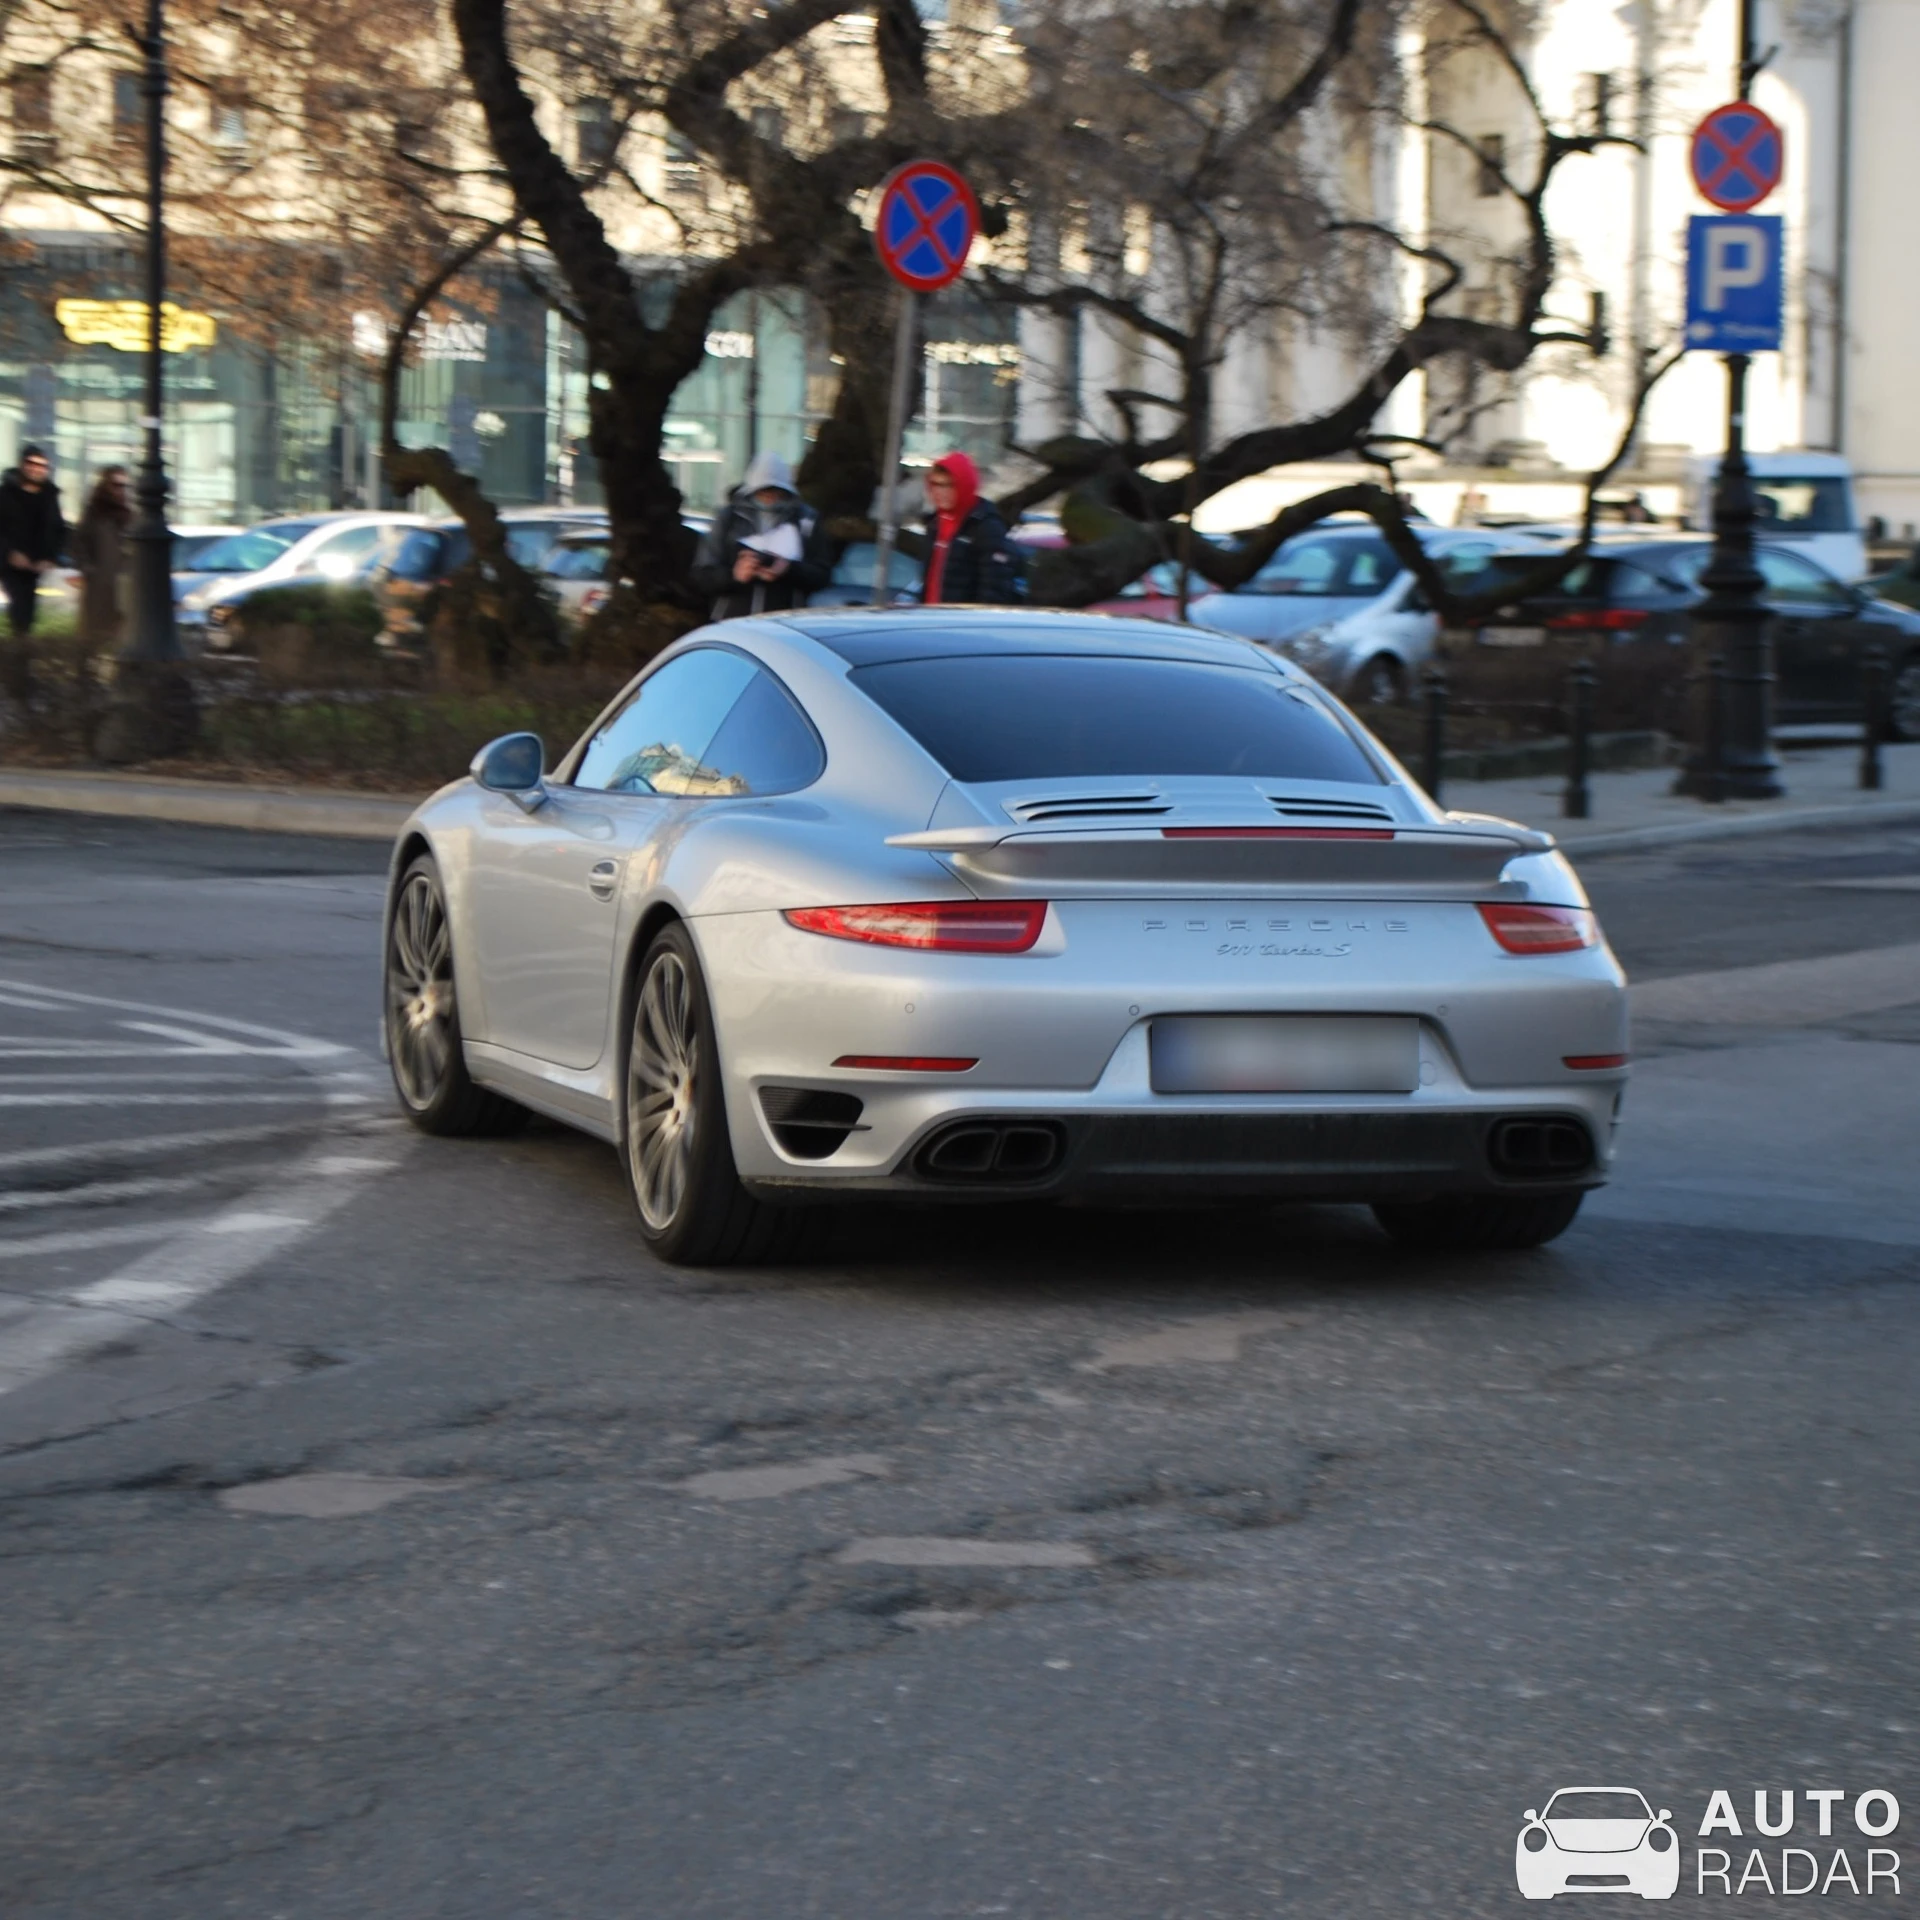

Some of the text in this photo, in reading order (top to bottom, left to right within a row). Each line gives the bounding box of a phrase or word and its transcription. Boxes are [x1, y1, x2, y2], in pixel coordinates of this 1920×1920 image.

[1701, 226, 1767, 312] P
[1141, 919, 1409, 932] PORSCHE
[1217, 942, 1352, 957] 911 Turbo S
